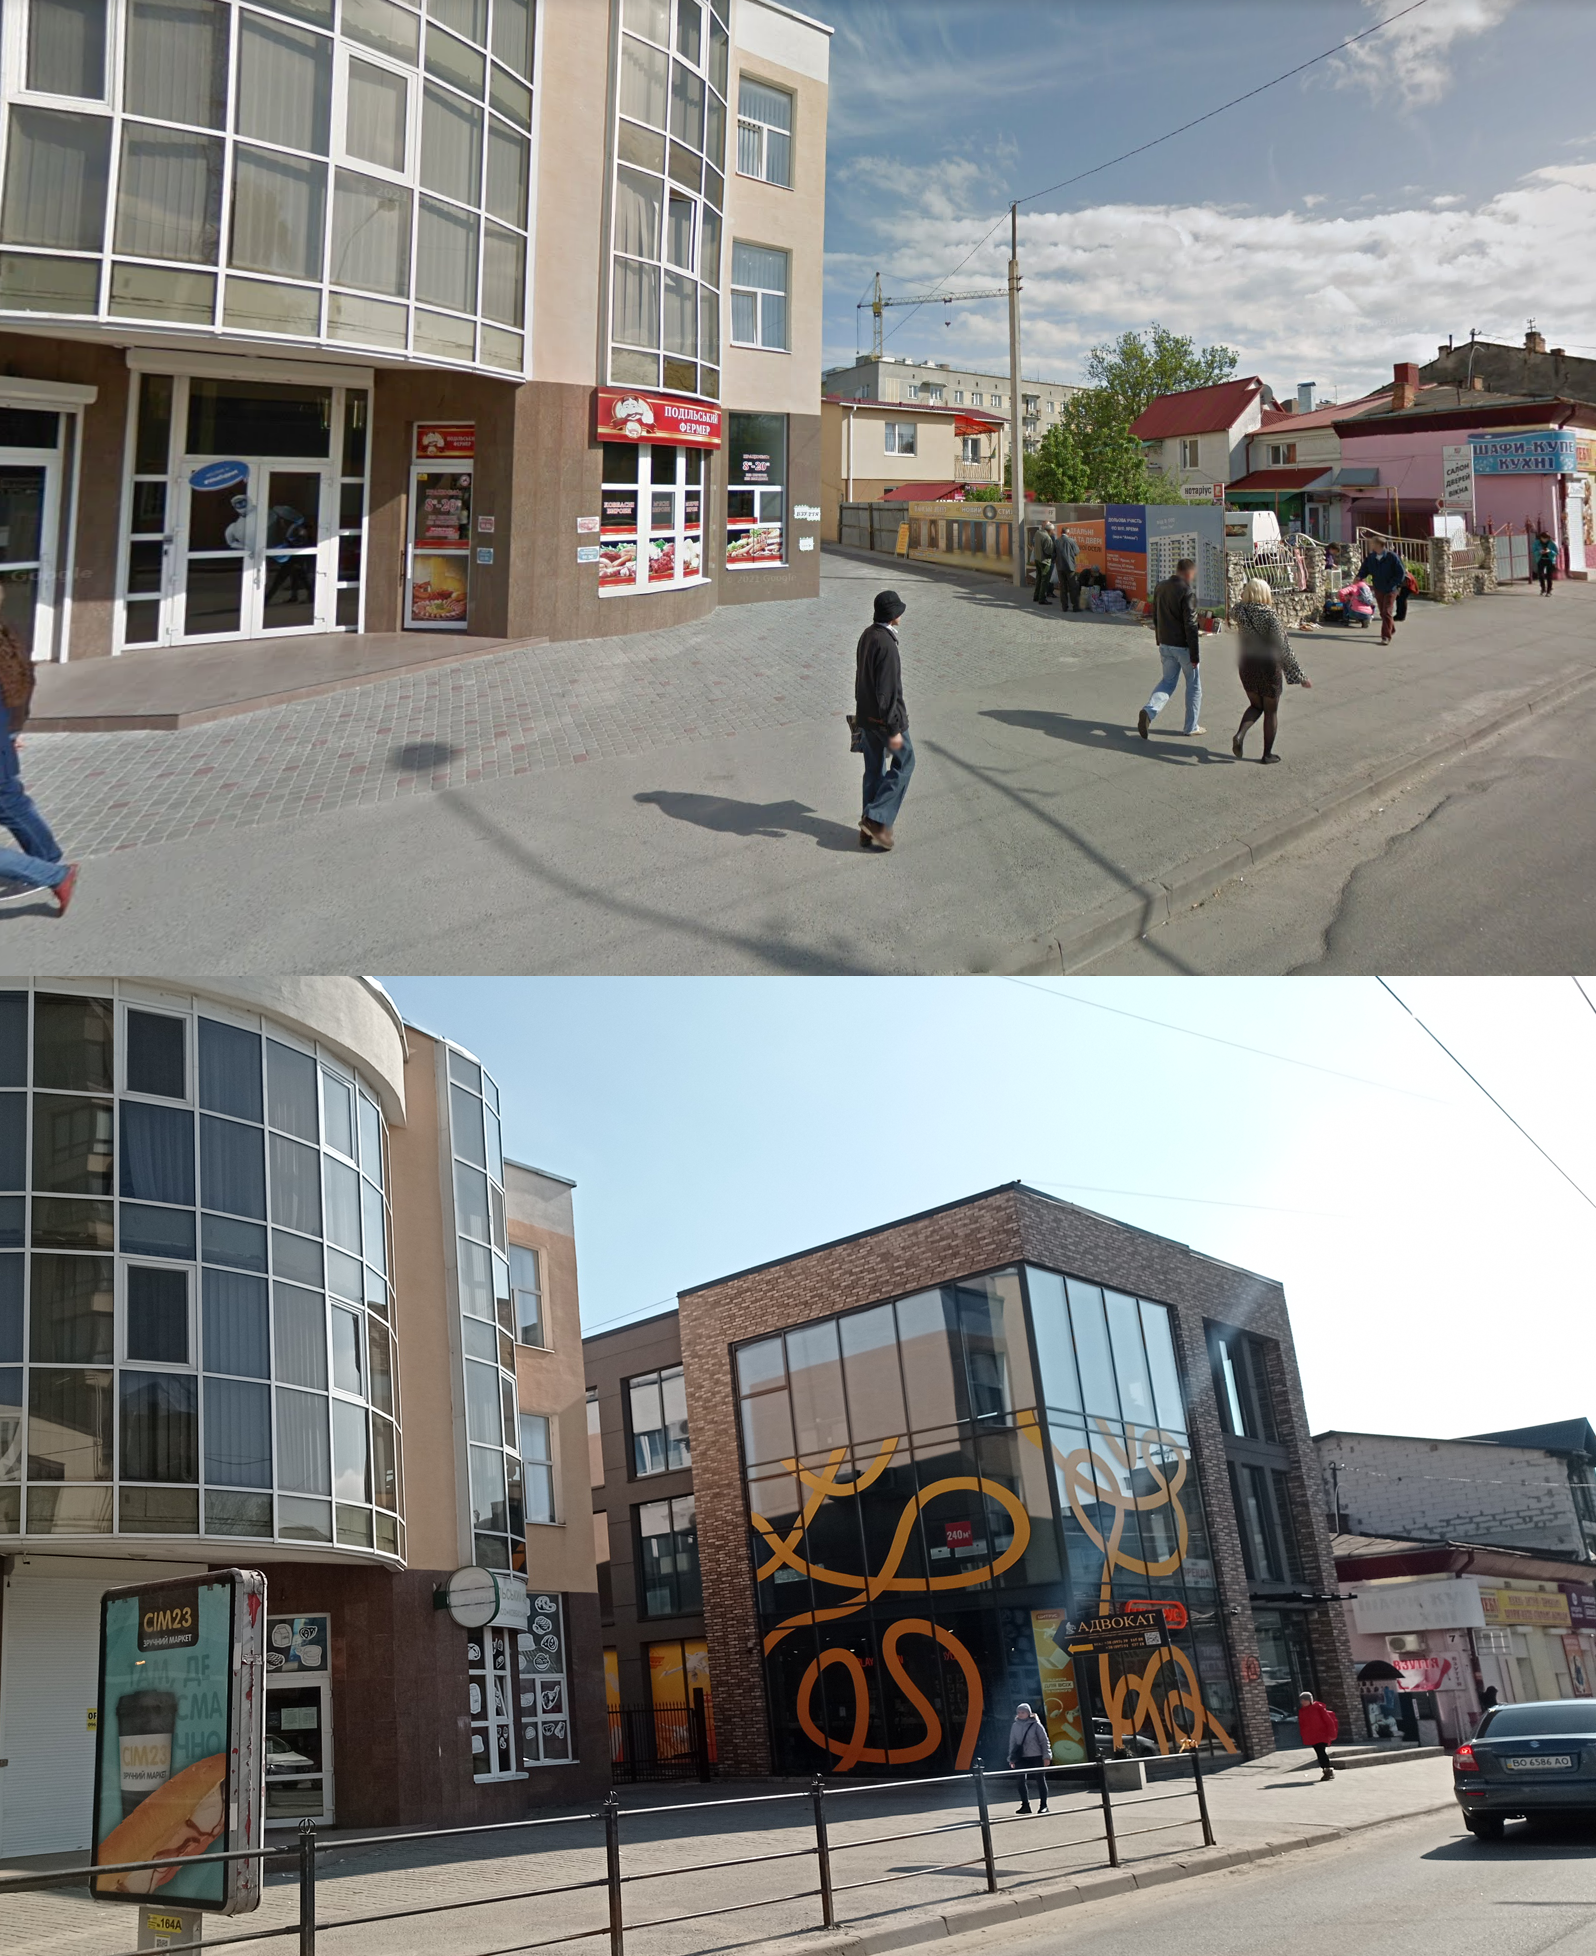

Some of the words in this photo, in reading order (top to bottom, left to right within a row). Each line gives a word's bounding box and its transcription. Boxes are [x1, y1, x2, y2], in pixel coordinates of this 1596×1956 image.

[664, 406, 719, 424] ПОДІЛЬСЬКИЙ
[679, 422, 711, 435] ФЕРМЕР
[1473, 440, 1575, 456] ШАФИ-КУПЕ
[1446, 463, 1470, 476] САЛОН
[1498, 457, 1556, 470] КУХНІ
[1446, 473, 1470, 488] ДВЕРЕЙ
[1184, 486, 1212, 496] нотаріус
[1448, 486, 1469, 498] ВІКНА
[1069, 526, 1094, 536] ДЕАЛЬНІ
[1085, 537, 1103, 546] ДВЕРІ
[1078, 1612, 1157, 1634] АДВОКАТ
[142, 1635, 169, 1648] ЗРУЧНИЙ
[169, 1633, 193, 1644] МАРКЕТ
[1448, 1635, 1456, 1643] 7
[1393, 1657, 1440, 1671] ВЗУТТЯ
[127, 1658, 176, 1689] ТАМ,
[183, 1653, 211, 1689] ДЕ
[177, 1691, 223, 1721] СМА
[175, 1730, 222, 1759] ЧНО
[1512, 1759, 1527, 1767] BO
[1529, 1758, 1552, 1766] 6586
[1555, 1757, 1569, 1765] AO
[146, 1770, 167, 1779] МАРКЕТ
